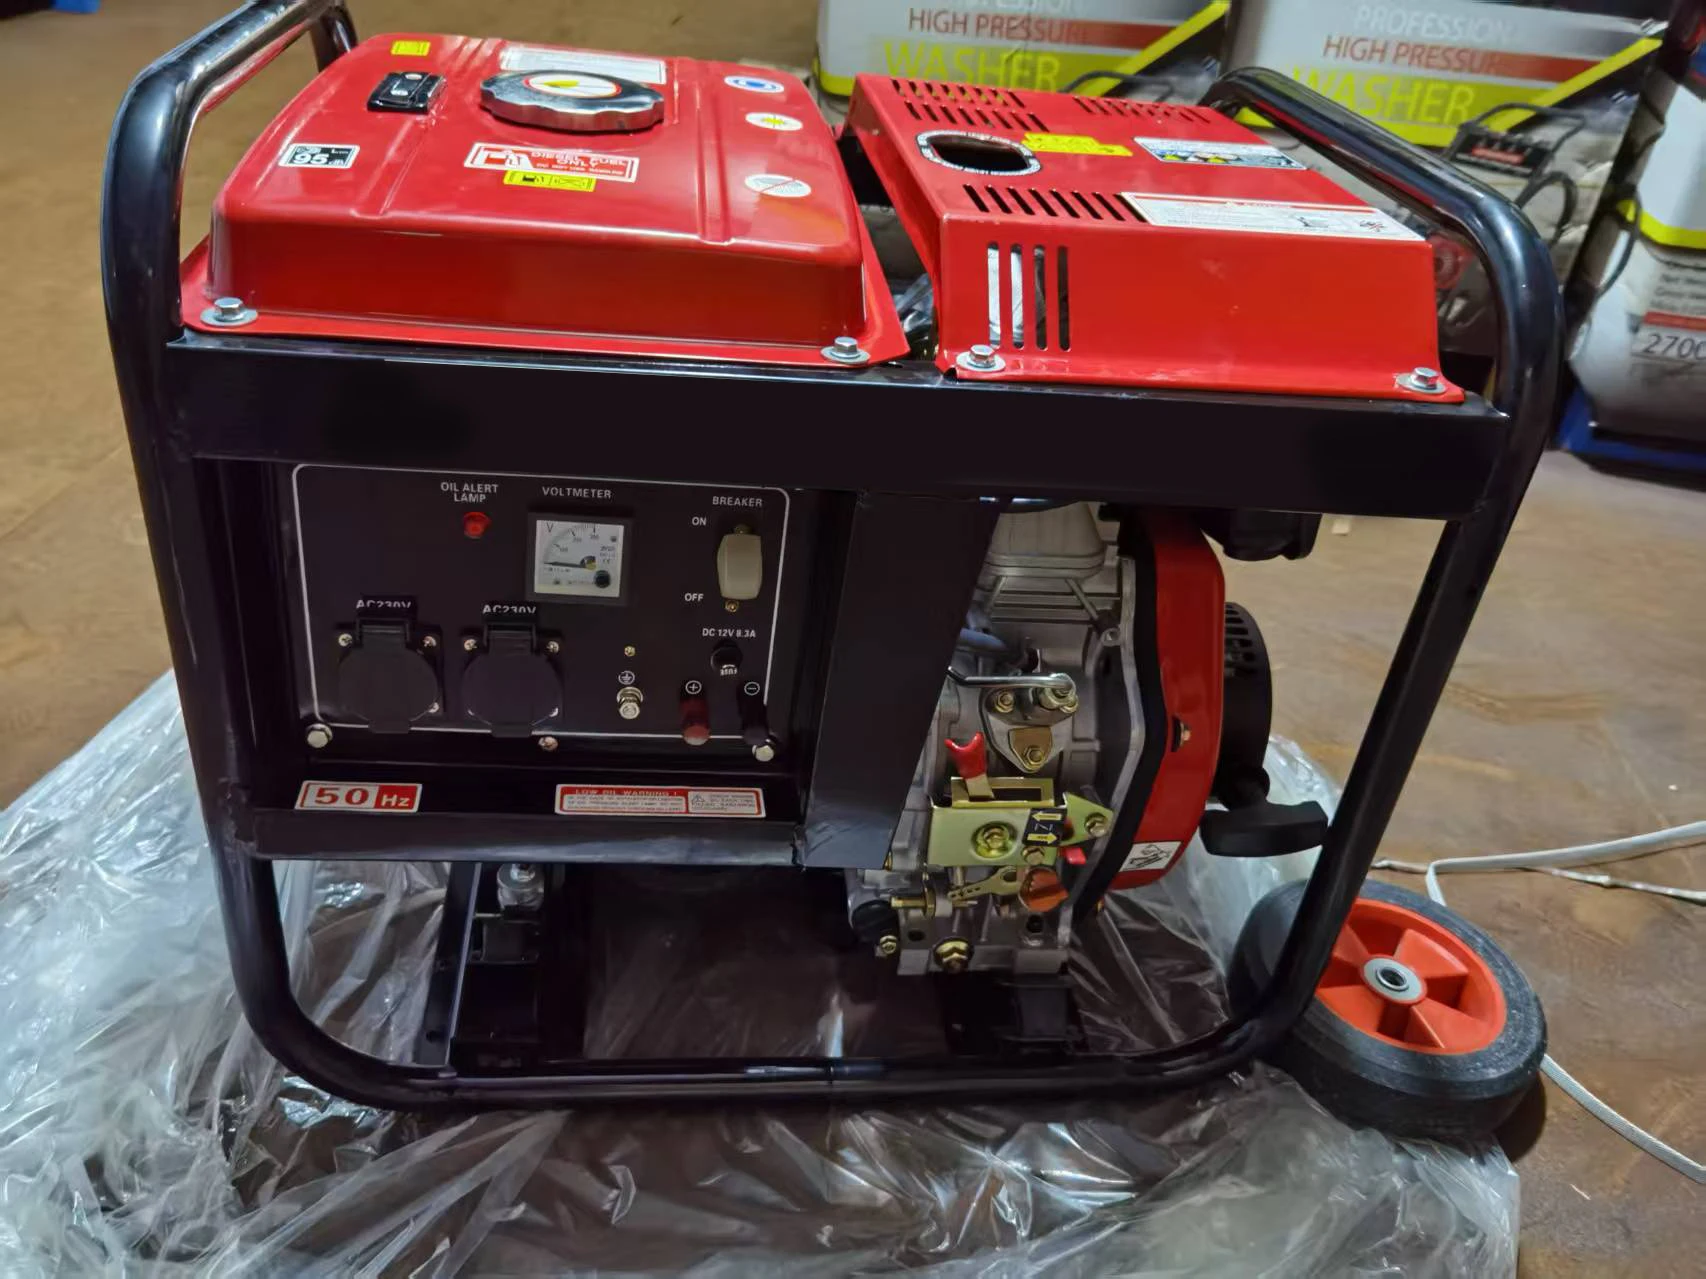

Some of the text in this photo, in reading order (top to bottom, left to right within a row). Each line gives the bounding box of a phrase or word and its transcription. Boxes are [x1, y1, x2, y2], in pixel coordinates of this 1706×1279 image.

[908, 7, 969, 36] HIGH
[1322, 34, 1390, 64] HIGH
[883, 40, 1061, 93] WASHER
[292, 152, 330, 165] 95
[440, 481, 499, 494] OIL ALERT
[541, 486, 612, 499] VOLTMETER
[453, 492, 487, 503] LAMP
[712, 495, 764, 507] BREAKER
[691, 516, 707, 526] ON
[684, 592, 704, 602] OFF
[355, 599, 412, 609] AC230V
[482, 604, 537, 614] AC230V
[702, 627, 716, 637] DC
[718, 628, 735, 638] 12V
[314, 786, 411, 808] 50 Hz
